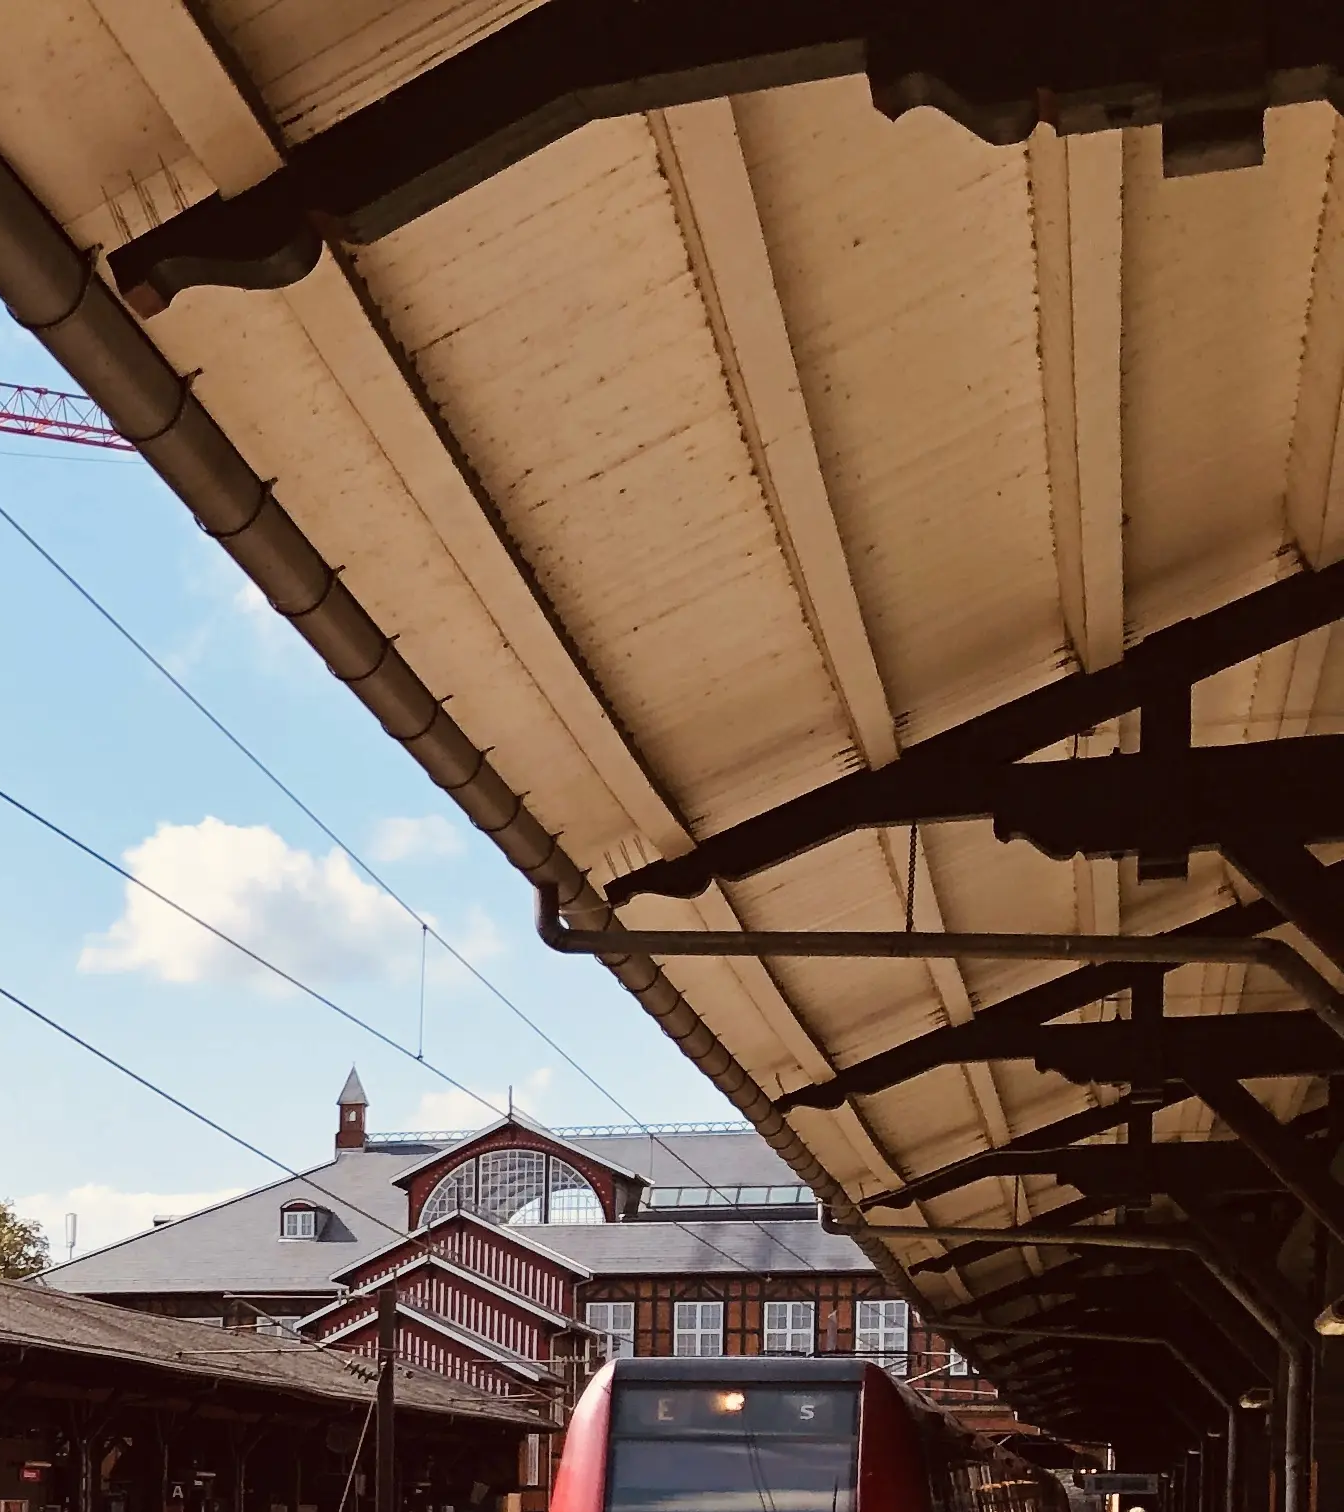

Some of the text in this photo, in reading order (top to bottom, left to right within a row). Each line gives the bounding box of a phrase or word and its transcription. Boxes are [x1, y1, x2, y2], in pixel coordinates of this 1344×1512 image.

[657, 1399, 815, 1421] E S
[172, 1485, 184, 1499] A
